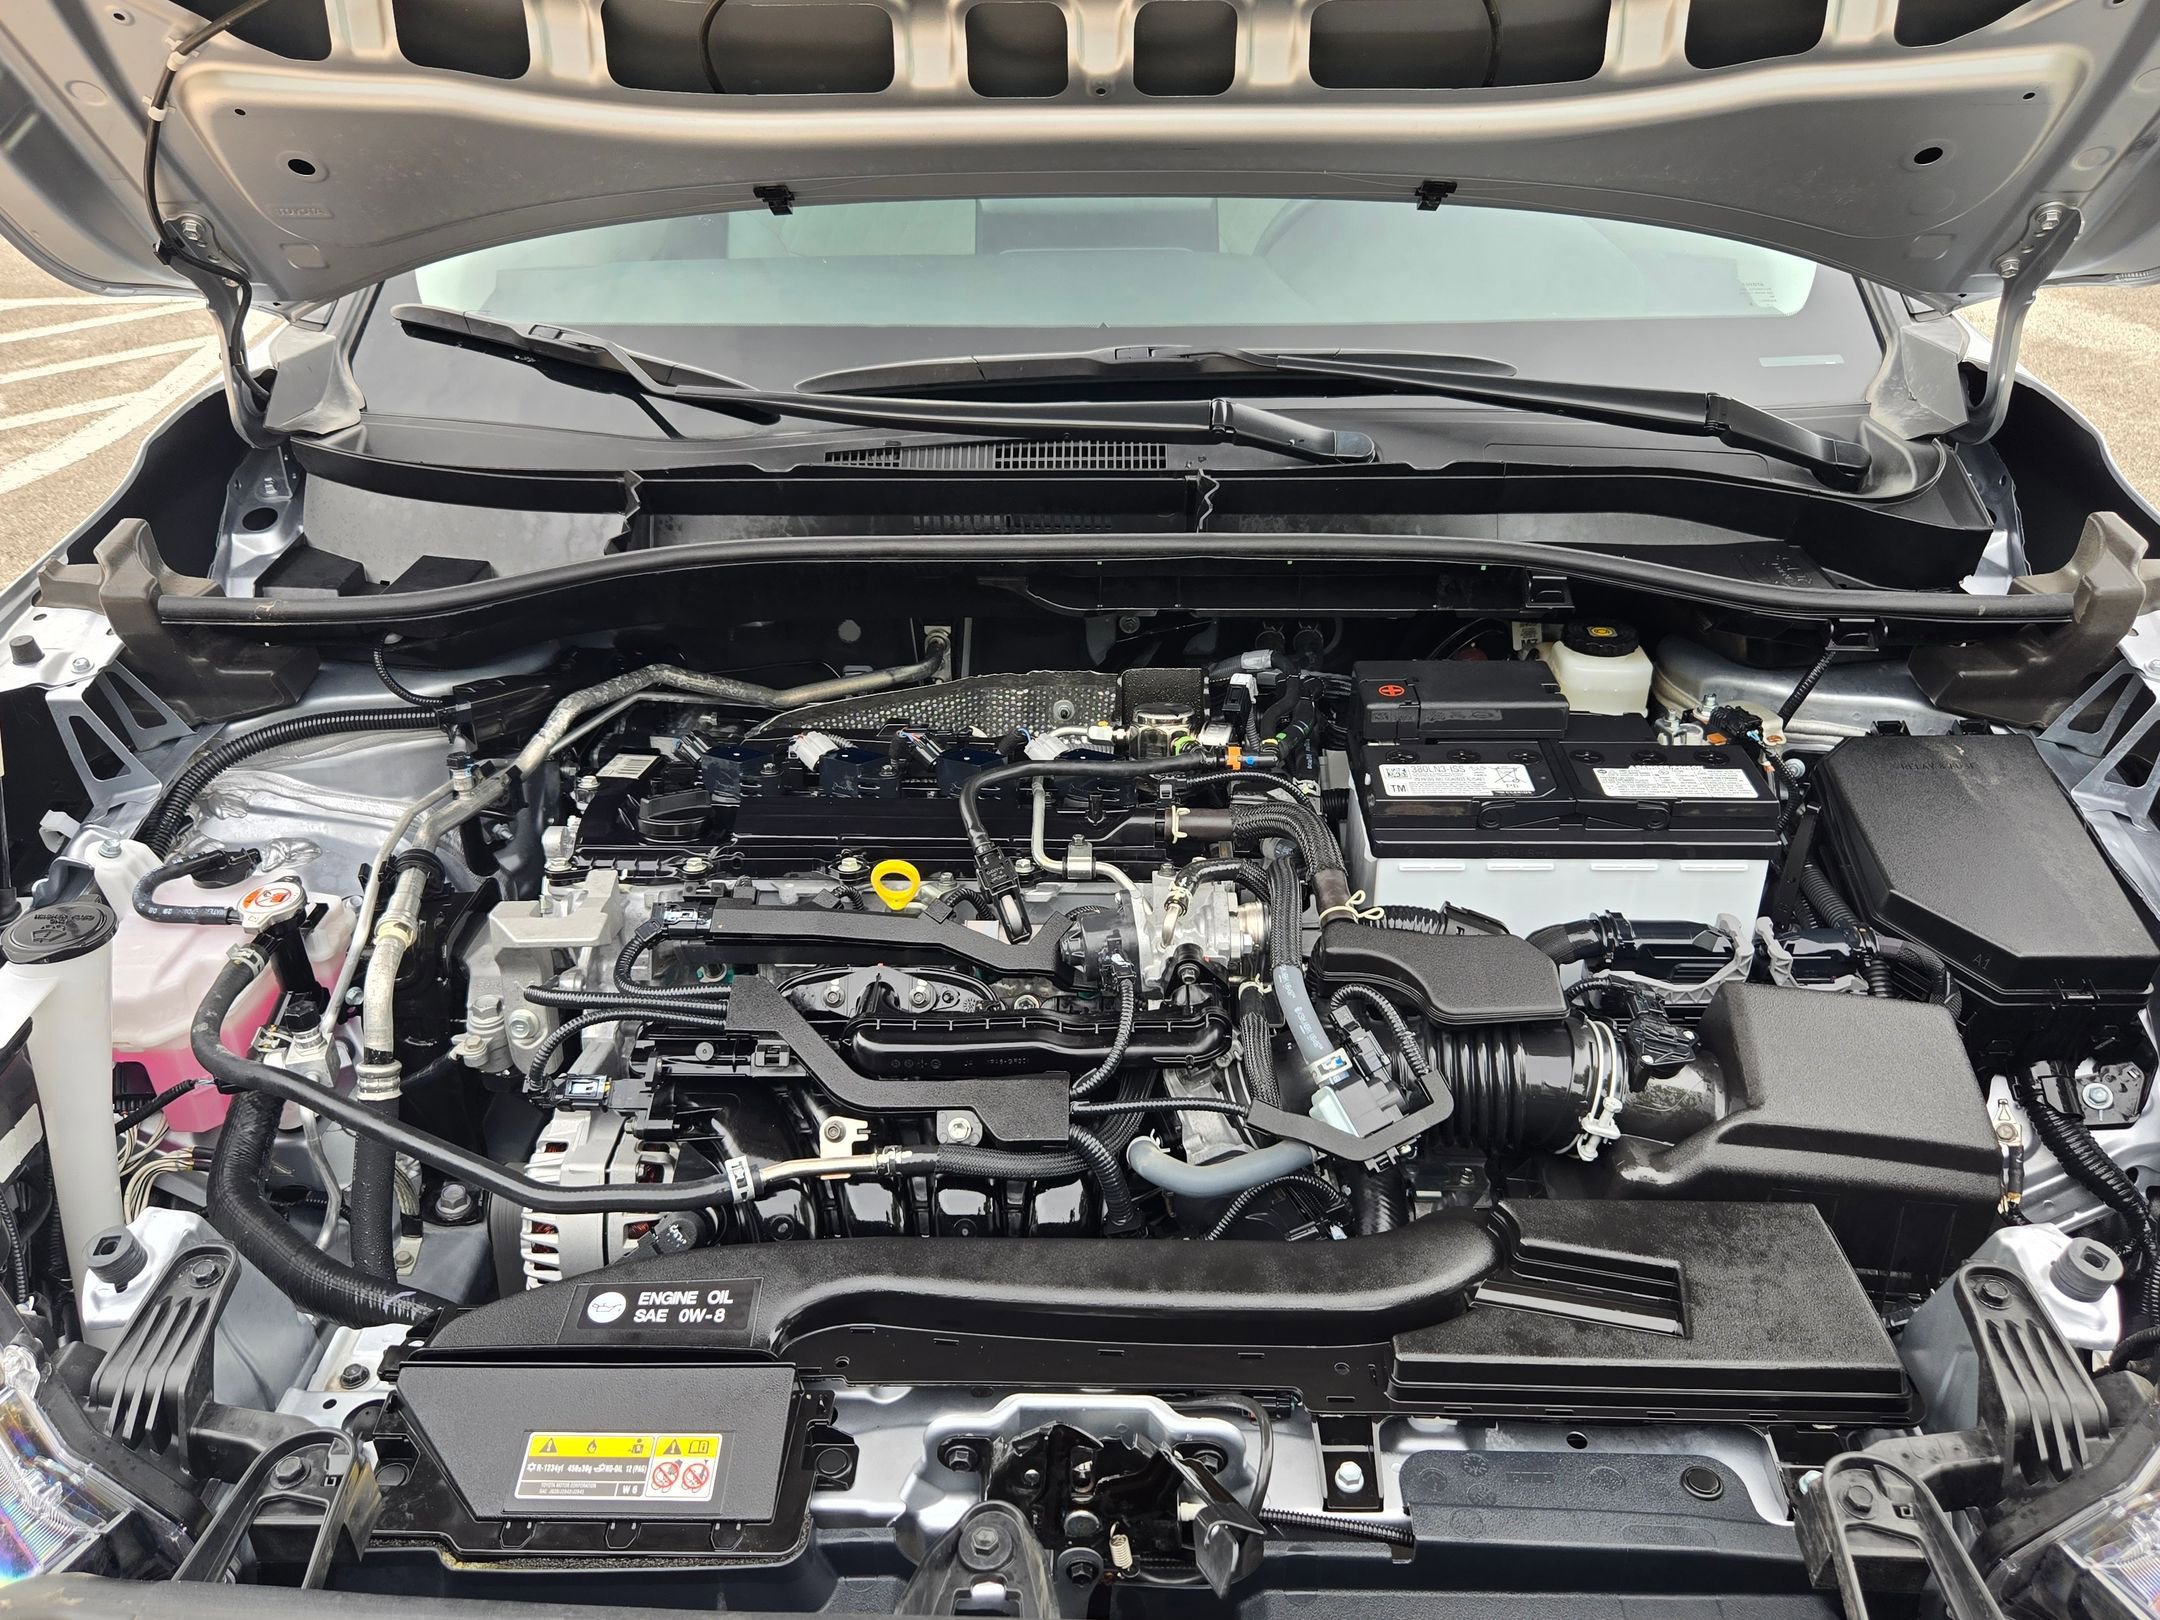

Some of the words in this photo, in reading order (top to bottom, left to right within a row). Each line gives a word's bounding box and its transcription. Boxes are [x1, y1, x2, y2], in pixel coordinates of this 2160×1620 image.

[1390, 784, 1407, 793] TM
[637, 1290, 699, 1306] ENGINE
[707, 1289, 734, 1304] OIL
[633, 1308, 669, 1323] SAE
[678, 1308, 726, 1323] 0W-8
